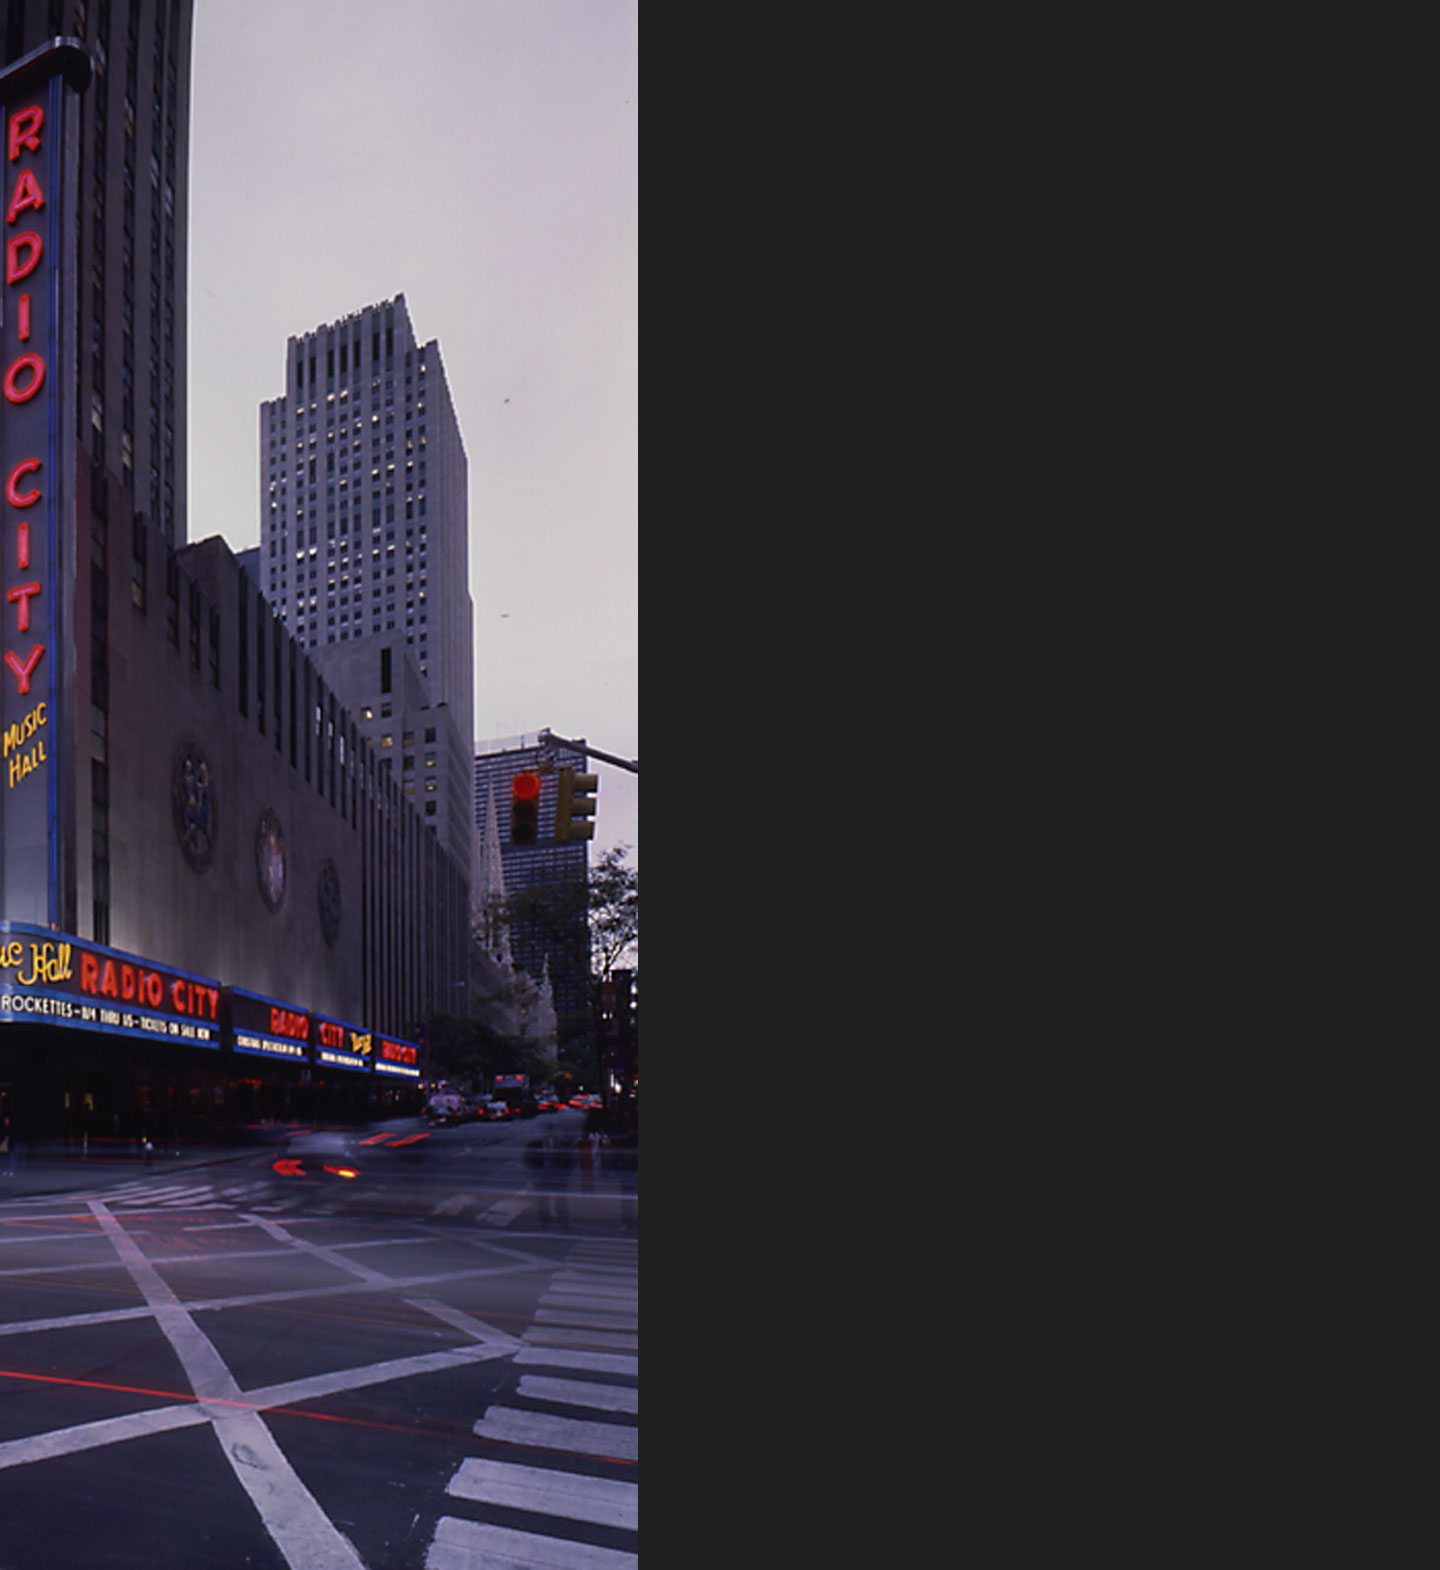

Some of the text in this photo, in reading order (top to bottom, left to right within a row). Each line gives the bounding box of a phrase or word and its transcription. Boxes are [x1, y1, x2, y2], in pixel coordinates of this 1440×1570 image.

[3, 105, 45, 694] RADIO CITY
[3, 702, 47, 758] MUSIC
[9, 741, 47, 788] HALL
[17, 941, 73, 985] Hall
[80, 952, 164, 1007] RADIO
[172, 979, 219, 1019] CITY
[320, 1021, 345, 1048] CITY
